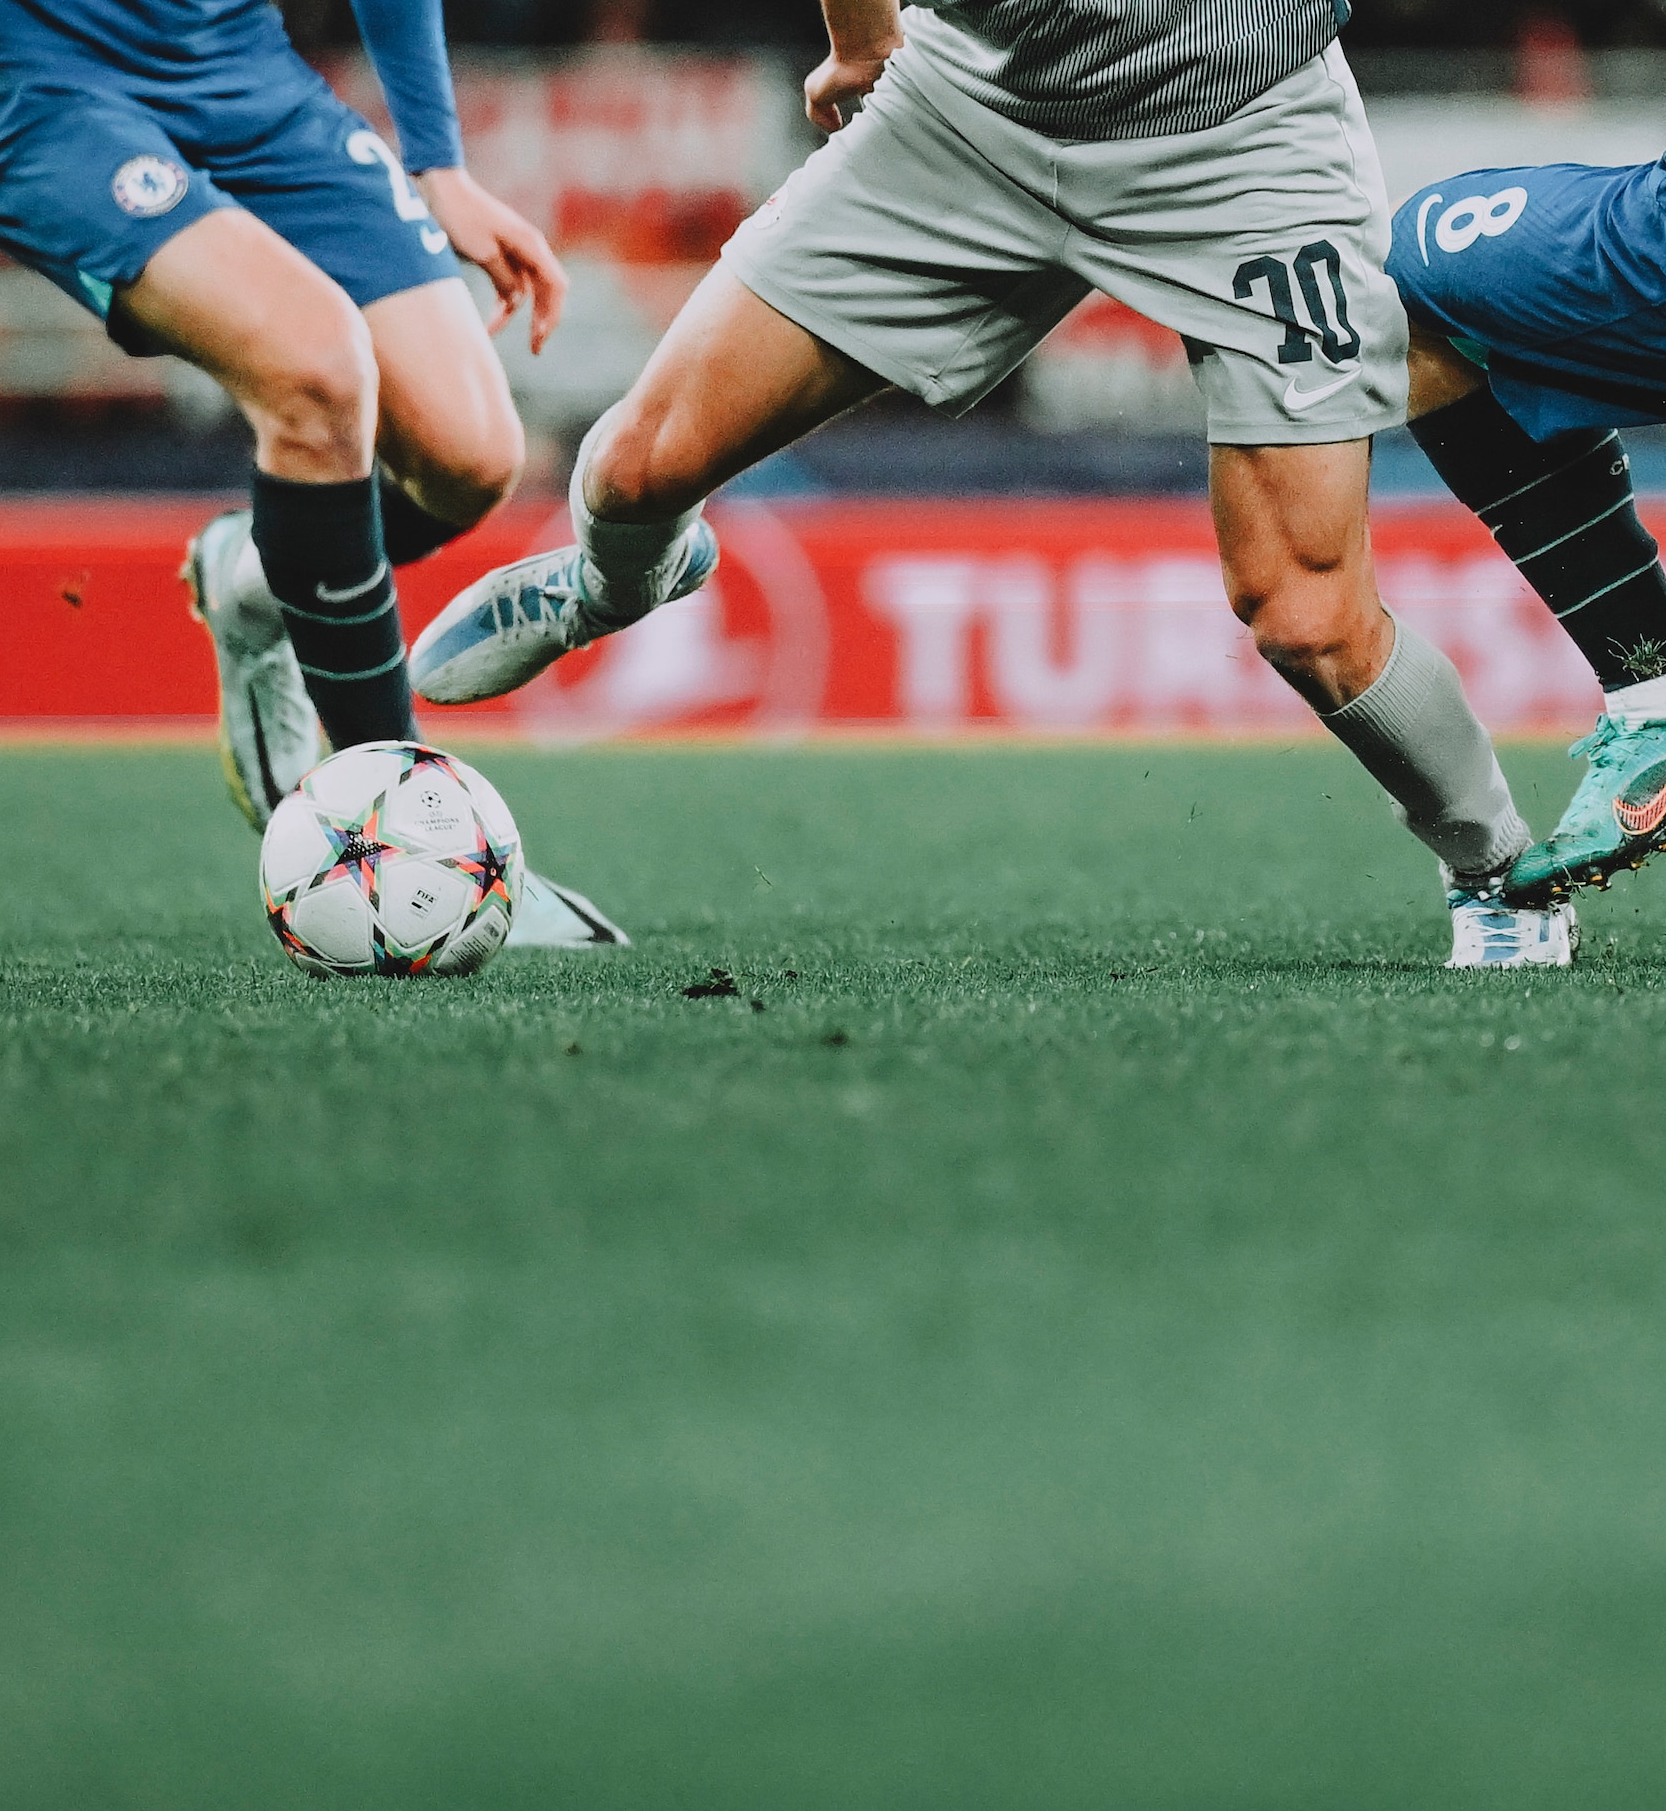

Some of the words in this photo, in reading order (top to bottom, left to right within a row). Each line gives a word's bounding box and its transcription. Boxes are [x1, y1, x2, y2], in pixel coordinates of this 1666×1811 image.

[1435, 186, 1527, 253] 8
[1232, 239, 1360, 364] 70
[416, 889, 436, 904] FIFA
